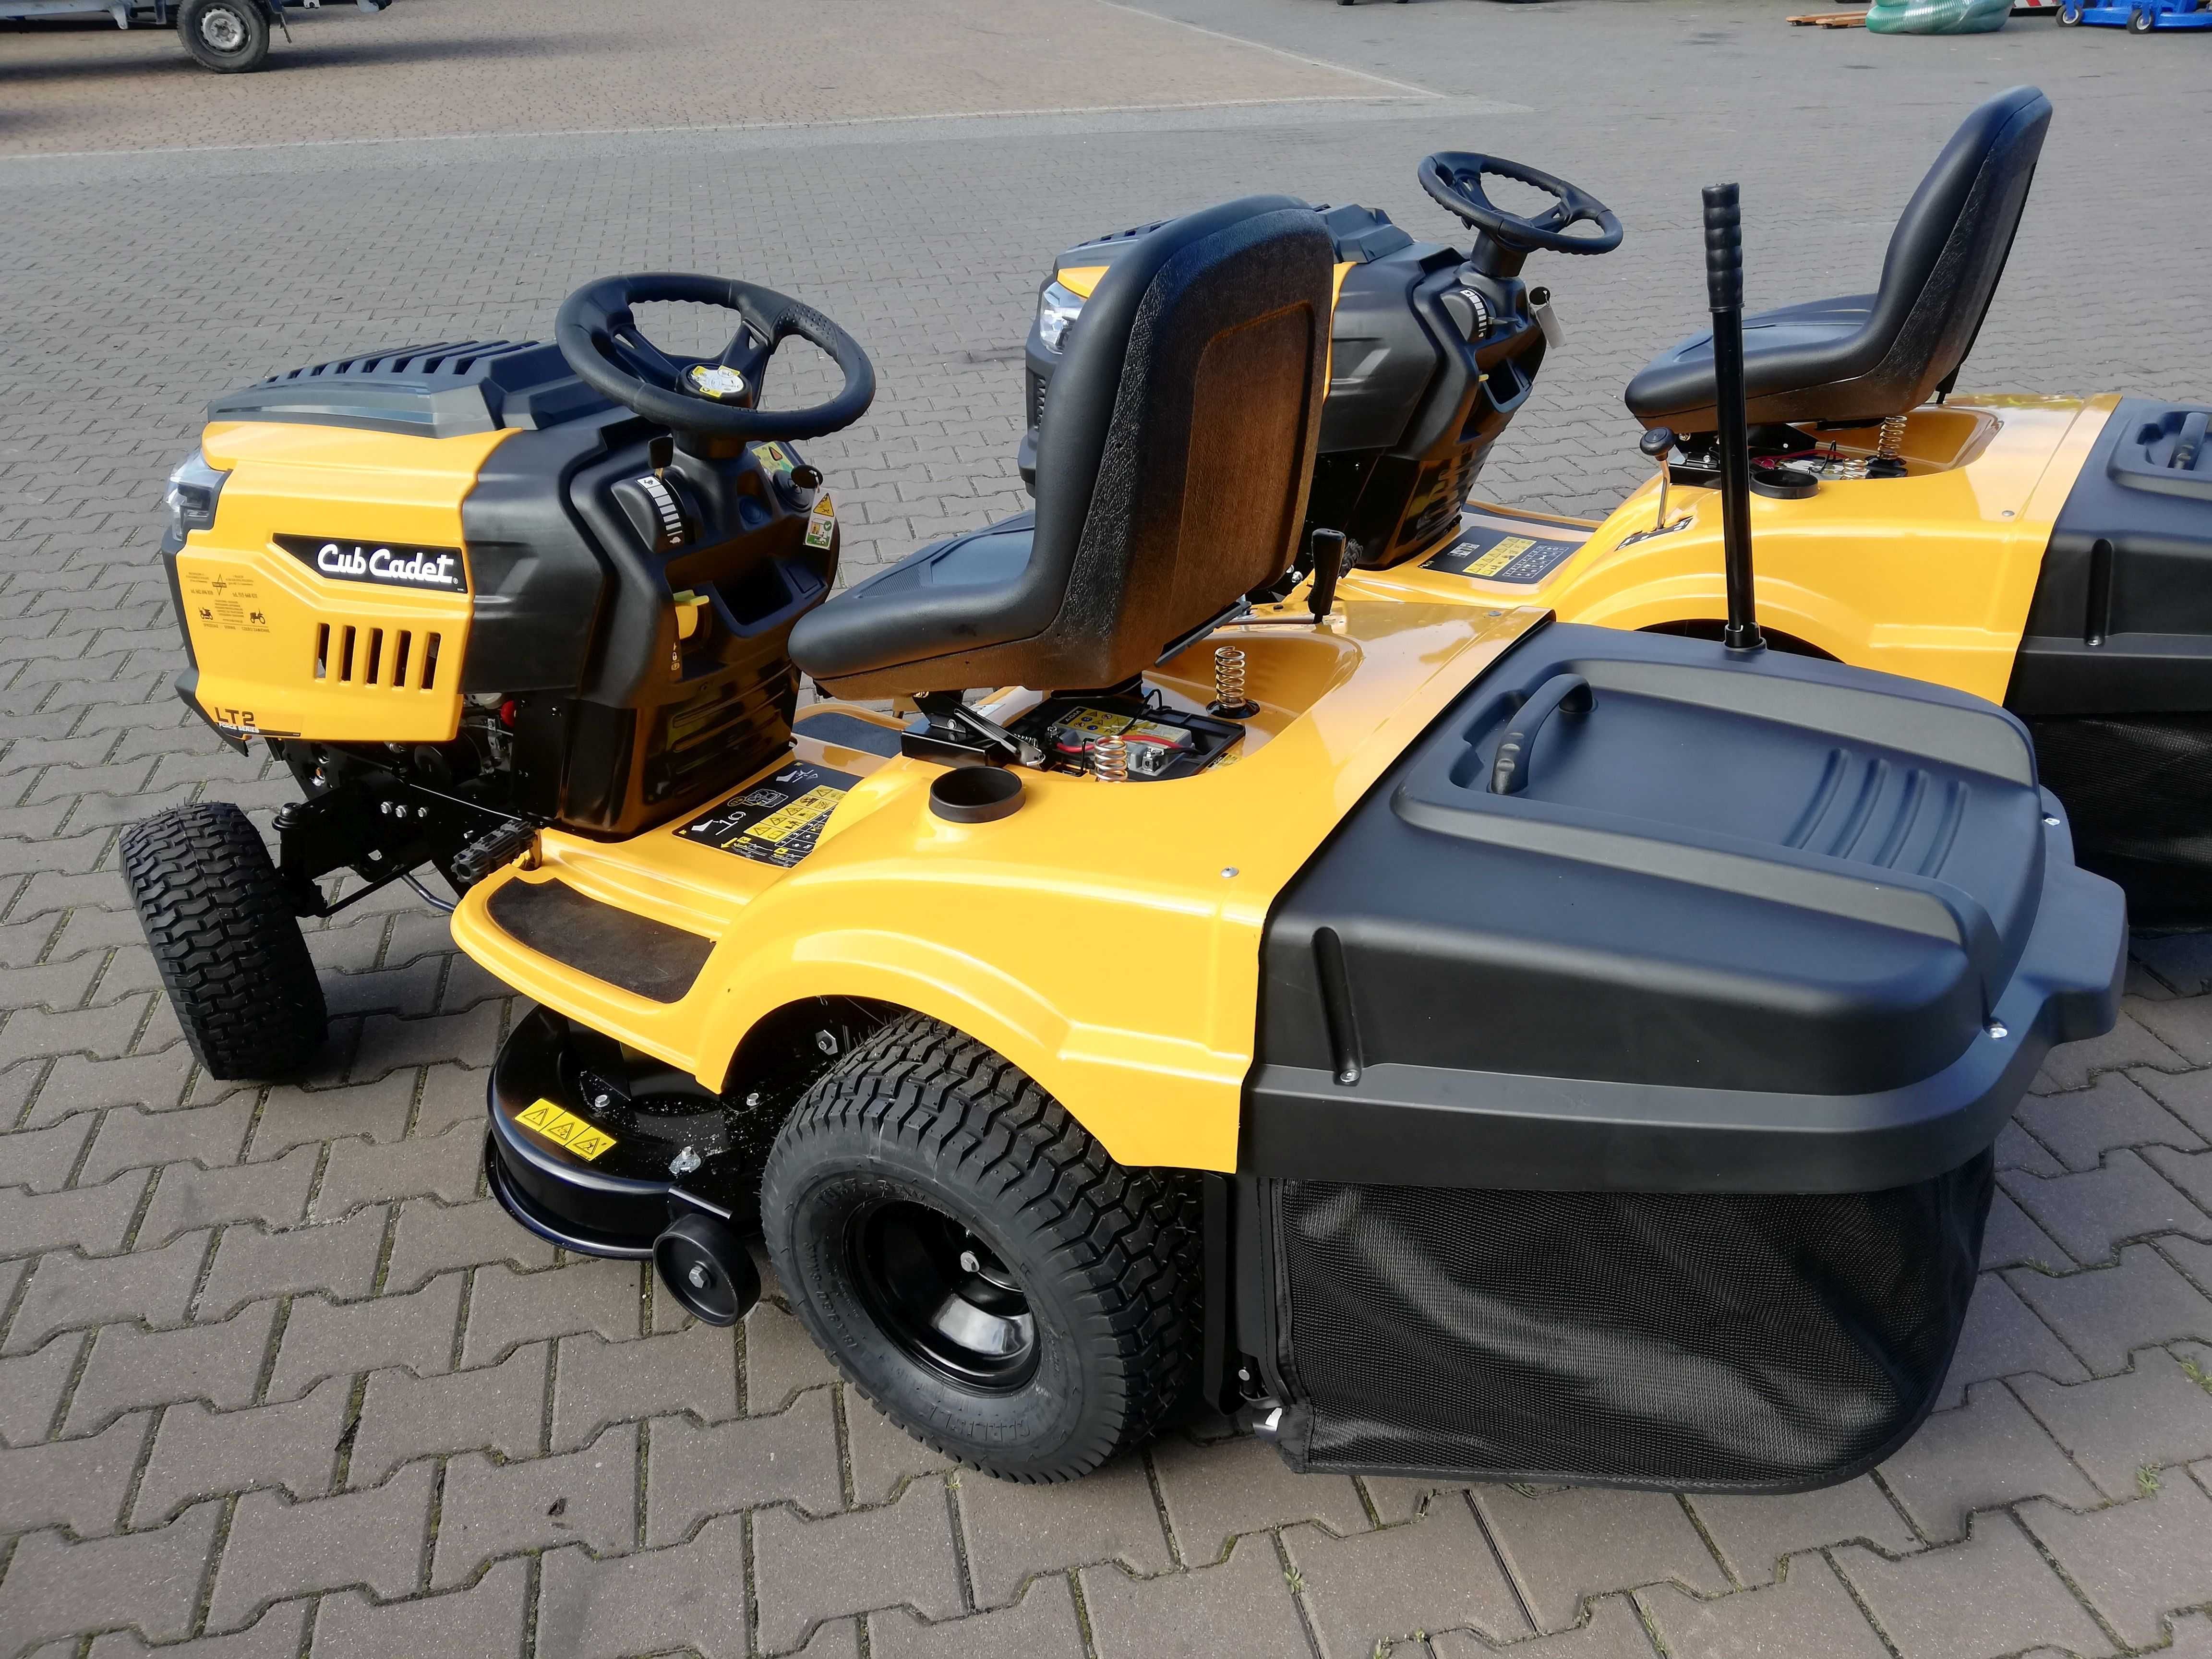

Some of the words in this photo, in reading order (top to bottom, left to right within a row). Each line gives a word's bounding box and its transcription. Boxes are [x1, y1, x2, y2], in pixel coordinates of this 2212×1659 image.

[317, 544, 366, 575] Cub
[369, 549, 454, 583] Cadet
[215, 707, 255, 727] LT2
[1064, 710, 1082, 722] AGM
